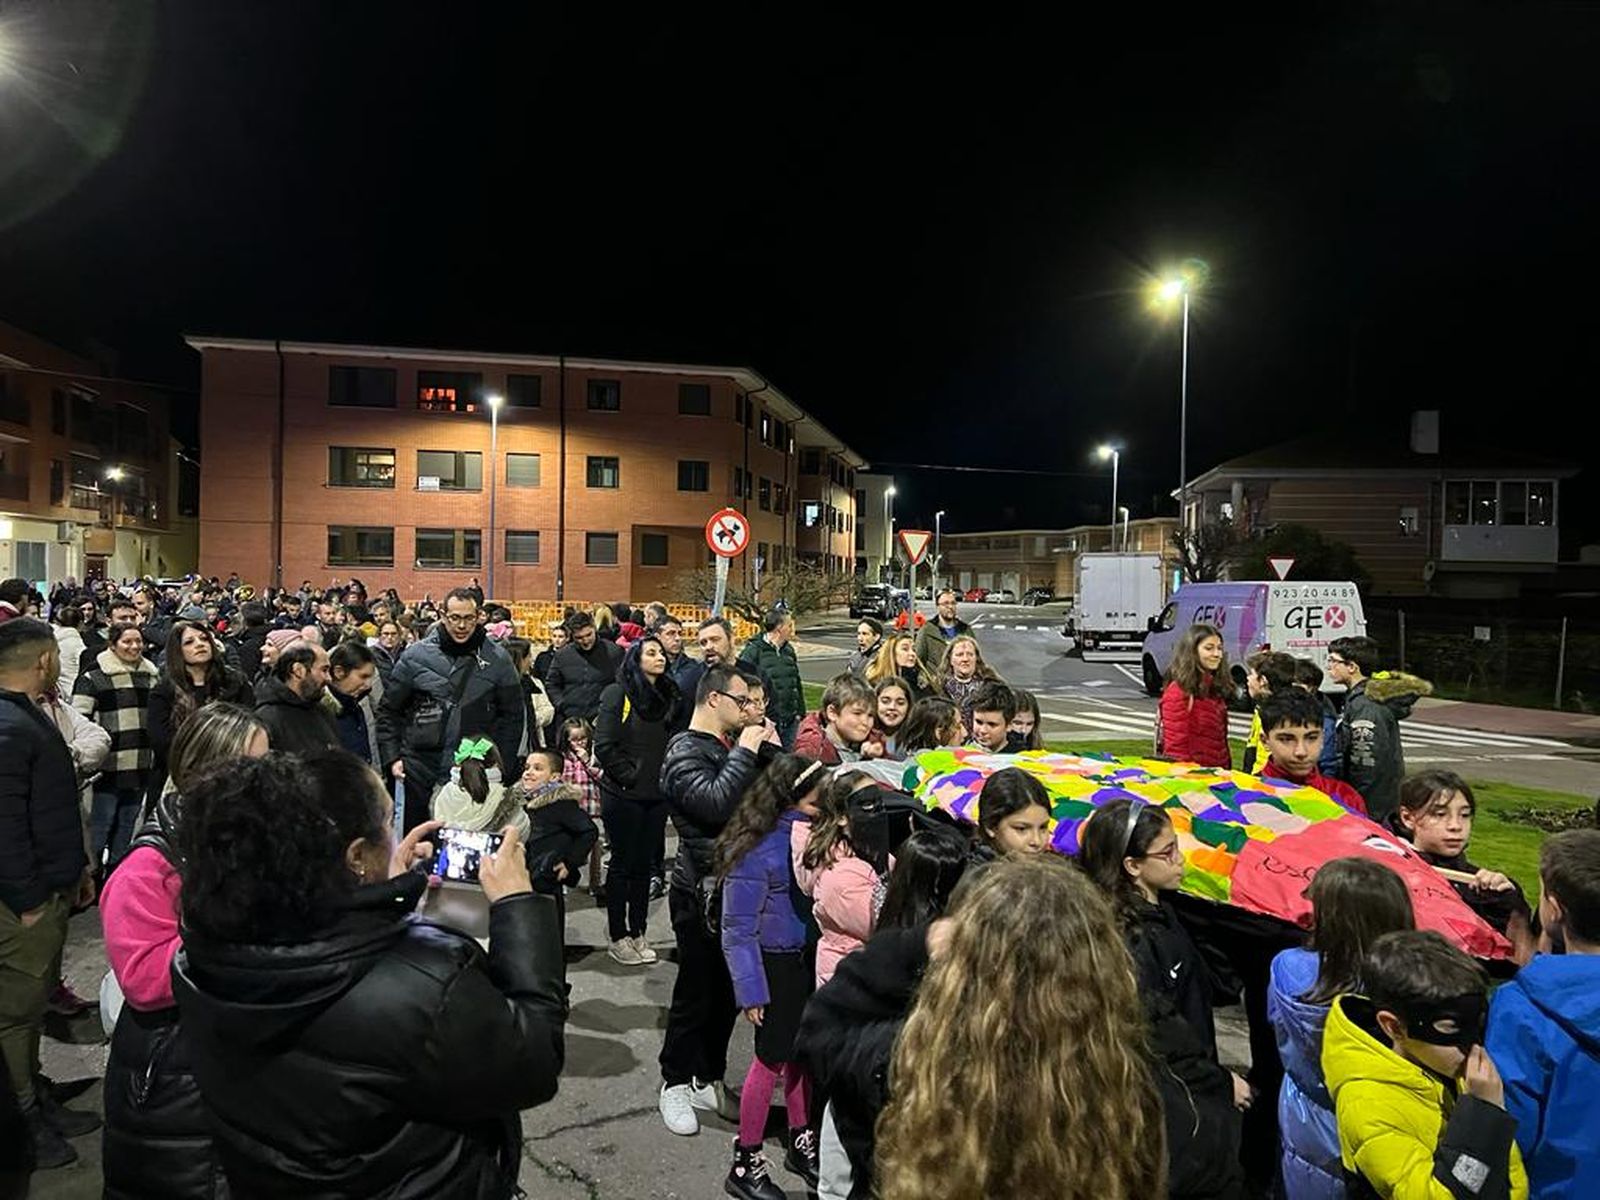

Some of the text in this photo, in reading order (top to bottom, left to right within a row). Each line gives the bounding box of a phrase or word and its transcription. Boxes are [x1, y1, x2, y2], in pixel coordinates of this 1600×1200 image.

[1273, 588, 1355, 598] 923 20 44 89
[1284, 604, 1346, 629] GEX
